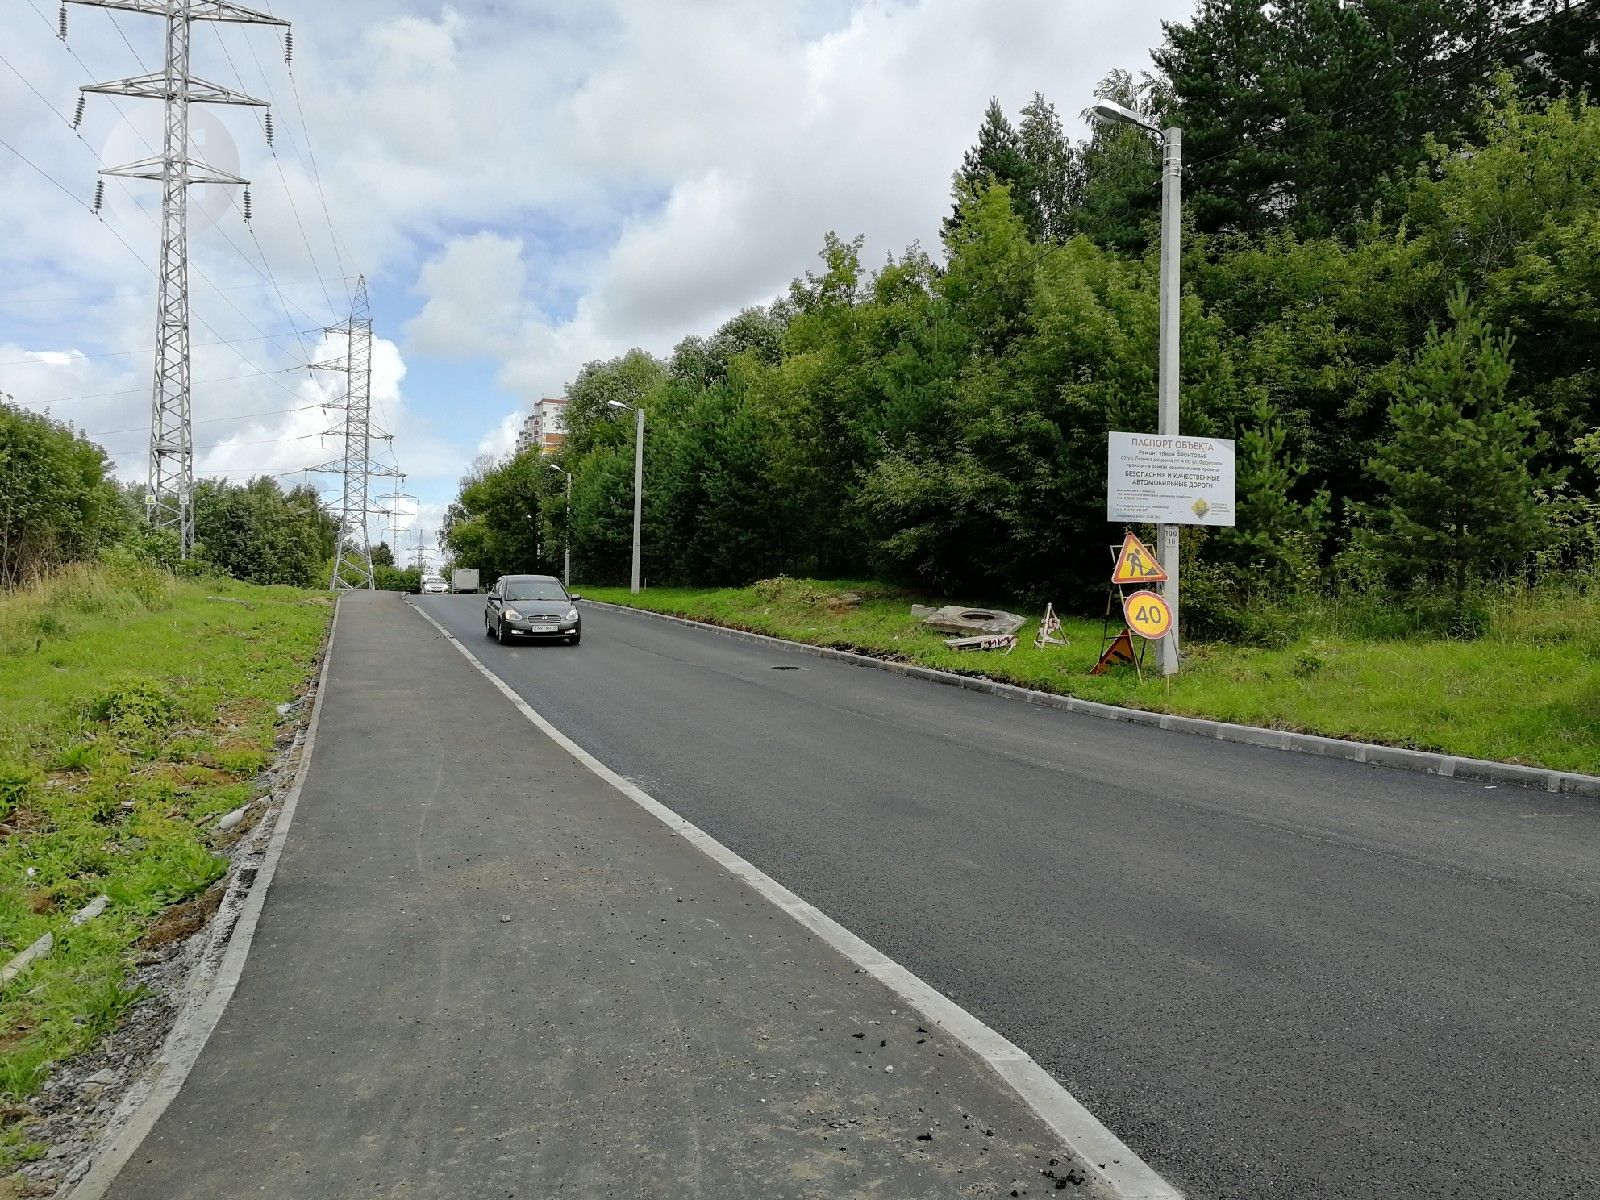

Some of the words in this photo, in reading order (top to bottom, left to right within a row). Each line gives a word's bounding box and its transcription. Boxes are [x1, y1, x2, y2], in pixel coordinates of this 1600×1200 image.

[1131, 437, 1173, 448] ПАСПОРТ
[1175, 440, 1214, 451] ОБЪЕКТА
[1173, 472, 1220, 482] КАЧЕСТВЕННЫЕ
[1131, 479, 1188, 489] АВТОМОБИЛЬНЫЕ
[1189, 481, 1213, 489] ДОРОГИ
[1135, 605, 1162, 624] 40
